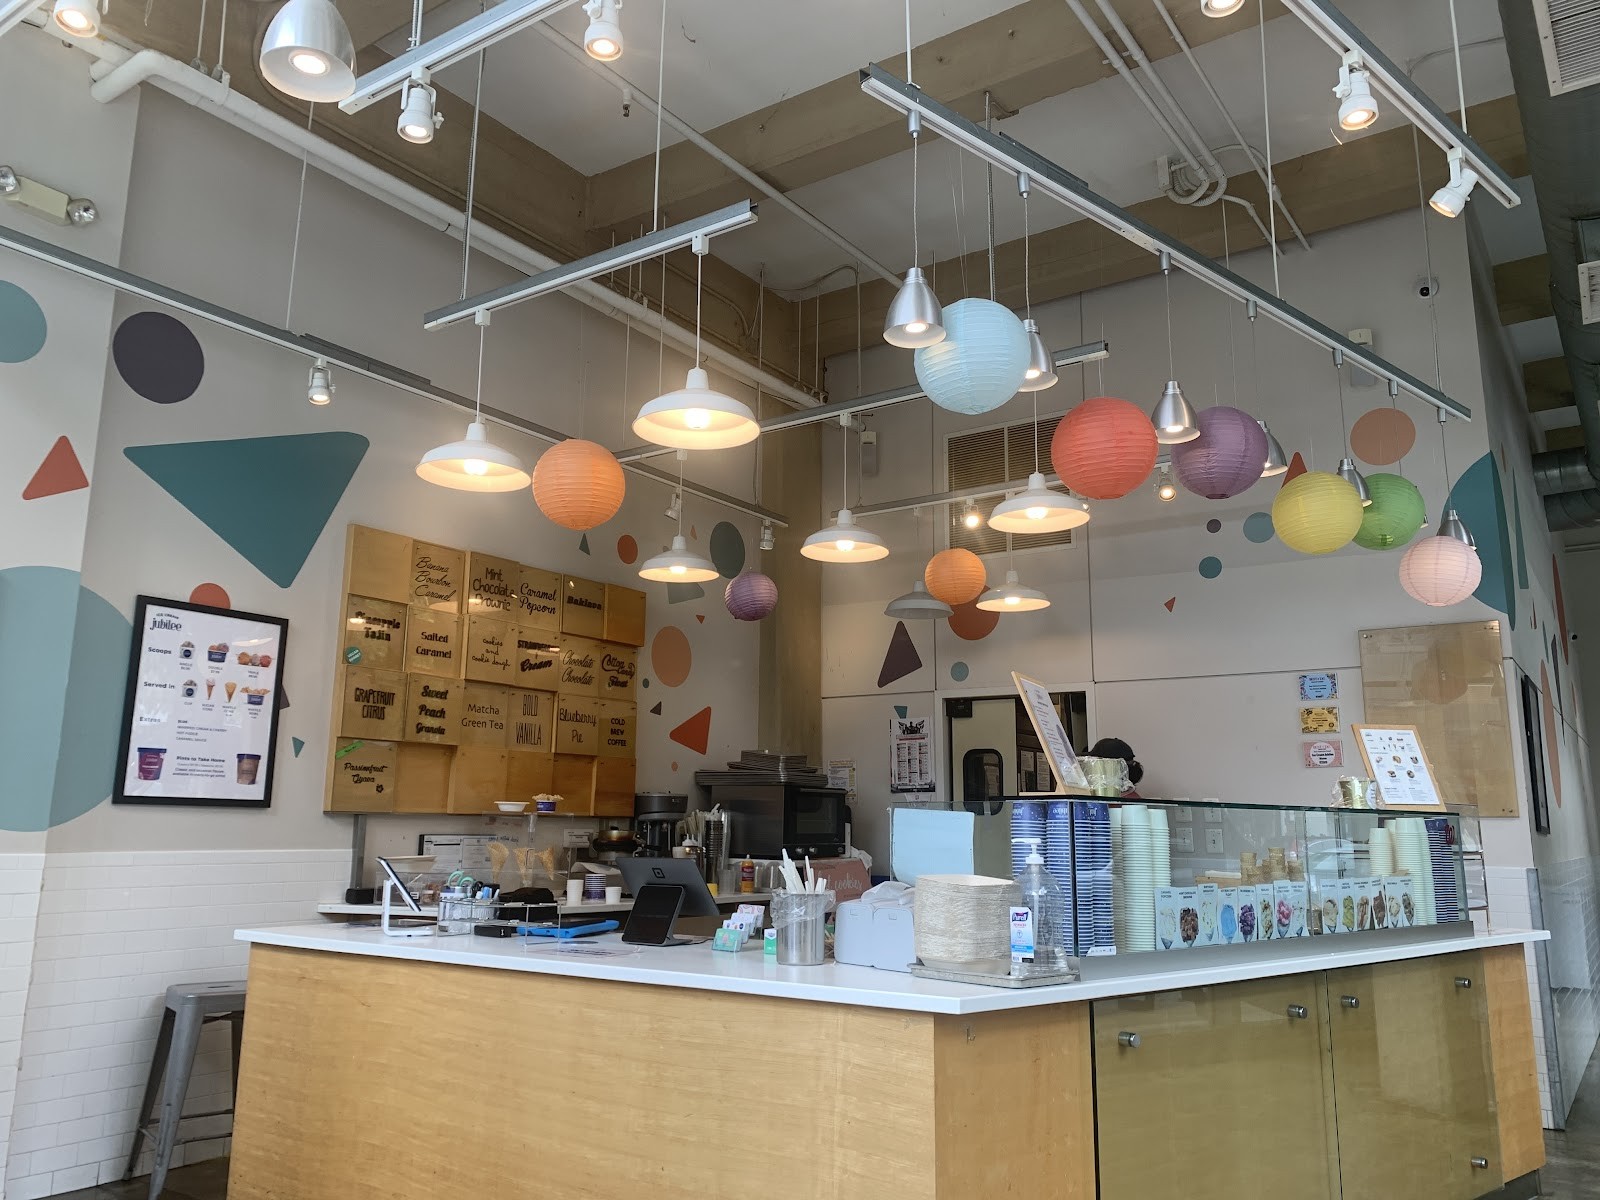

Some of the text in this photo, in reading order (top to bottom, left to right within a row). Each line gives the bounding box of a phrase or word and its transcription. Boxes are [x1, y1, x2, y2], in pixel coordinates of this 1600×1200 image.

[416, 556, 450, 573] Banana
[415, 570, 451, 587] Bourbon
[485, 567, 504, 582] Mint
[415, 584, 457, 601] Caramel
[472, 577, 515, 599] Chocolate
[520, 582, 557, 602] Caramel
[519, 595, 557, 615] Popcorn
[149, 617, 182, 632] jubilee
[354, 611, 401, 630] Pneapple
[421, 631, 449, 643] Salted
[147, 646, 172, 655] Scoops
[416, 646, 452, 659] Caramel
[485, 646, 499, 656] and
[471, 653, 511, 671] cookie dough
[520, 658, 553, 672] Cream
[563, 649, 596, 669] Chocolate
[601, 654, 626, 672] Cotton
[561, 666, 595, 686] Chocolate
[143, 681, 167, 689] Served
[421, 685, 449, 700] Sweet
[354, 687, 396, 706] GRAPEFRUIT
[362, 704, 386, 720] CITRUS
[418, 704, 446, 719] Peach
[467, 703, 500, 715] Matcha
[461, 717, 504, 730] Green Tea
[559, 708, 597, 727] Blueberry
[610, 718, 626, 726] COLD
[415, 722, 446, 735] Granola
[516, 721, 542, 746] VANILLA
[571, 729, 584, 743] Pie
[610, 728, 625, 736] BREW
[607, 739, 627, 747] COFFEE
